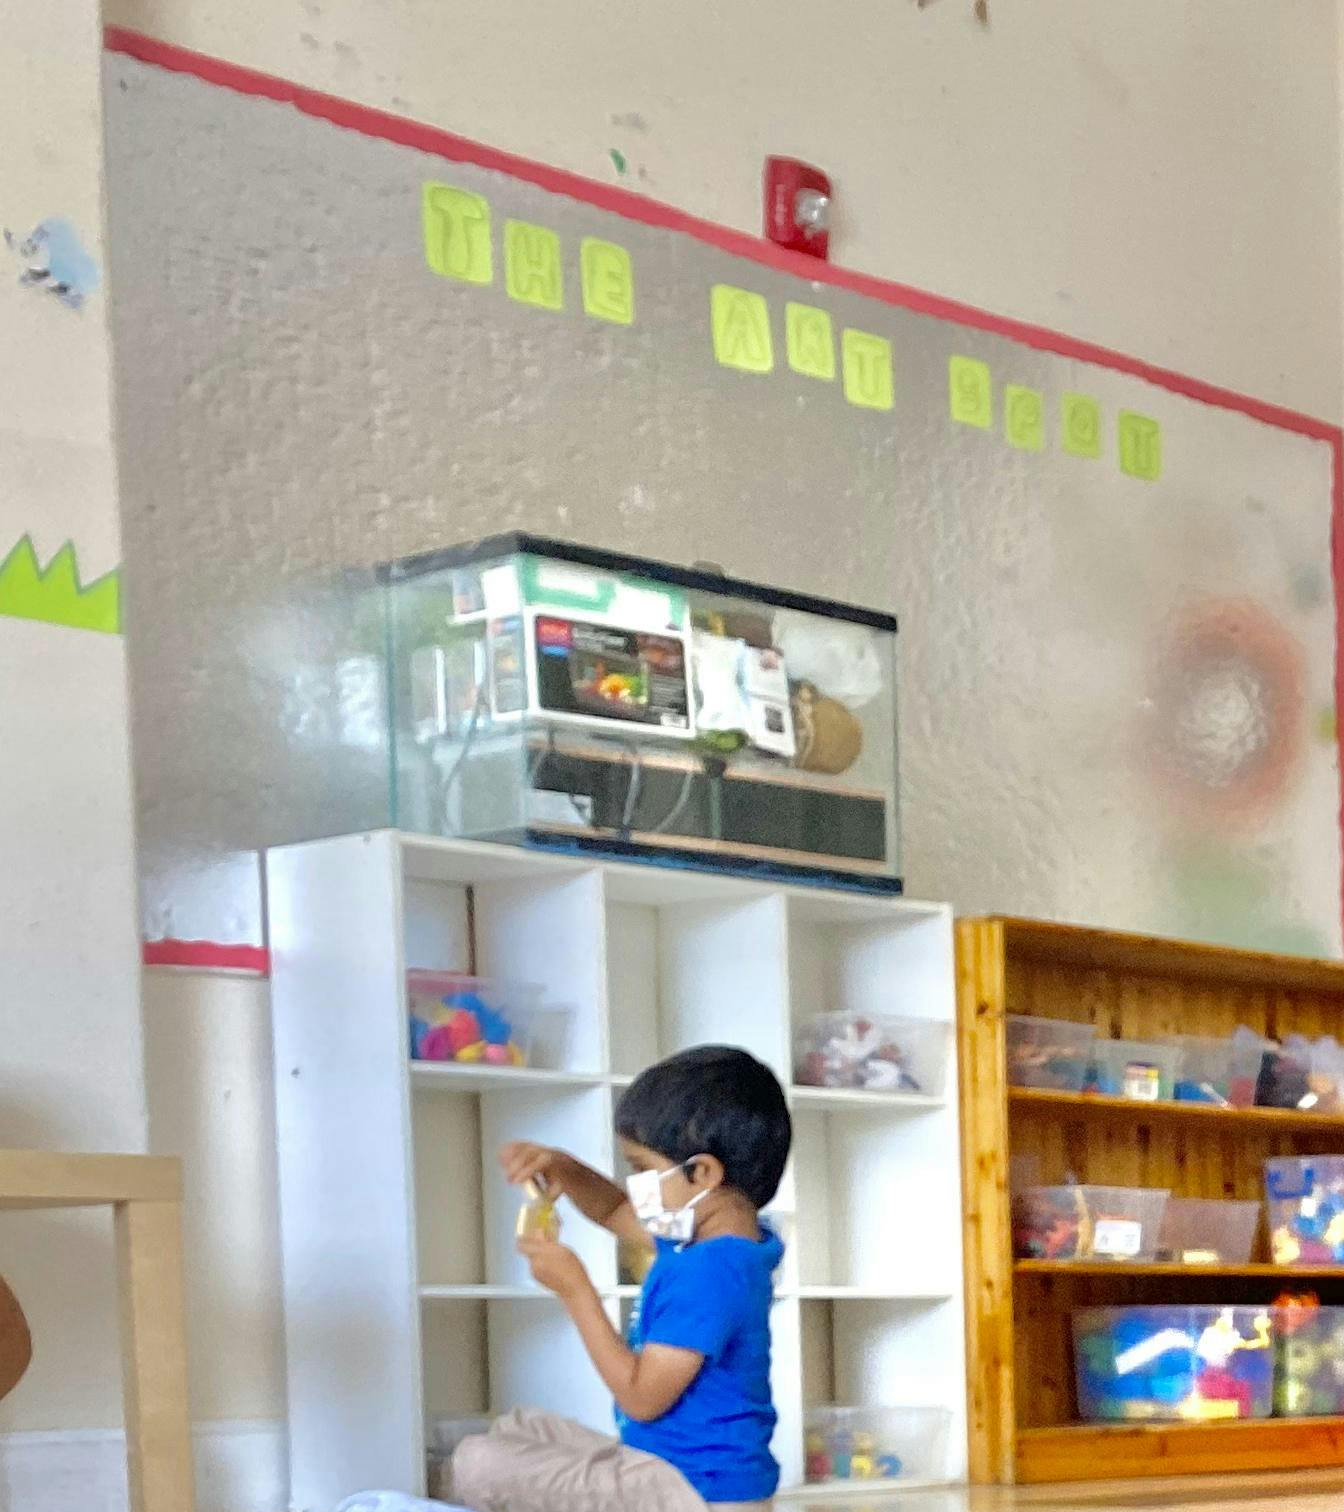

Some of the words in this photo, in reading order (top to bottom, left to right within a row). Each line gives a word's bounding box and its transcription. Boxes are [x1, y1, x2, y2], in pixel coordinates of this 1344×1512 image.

[424, 182, 632, 323] THE
[714, 287, 893, 408] ART
[951, 358, 1161, 478] SPOT
